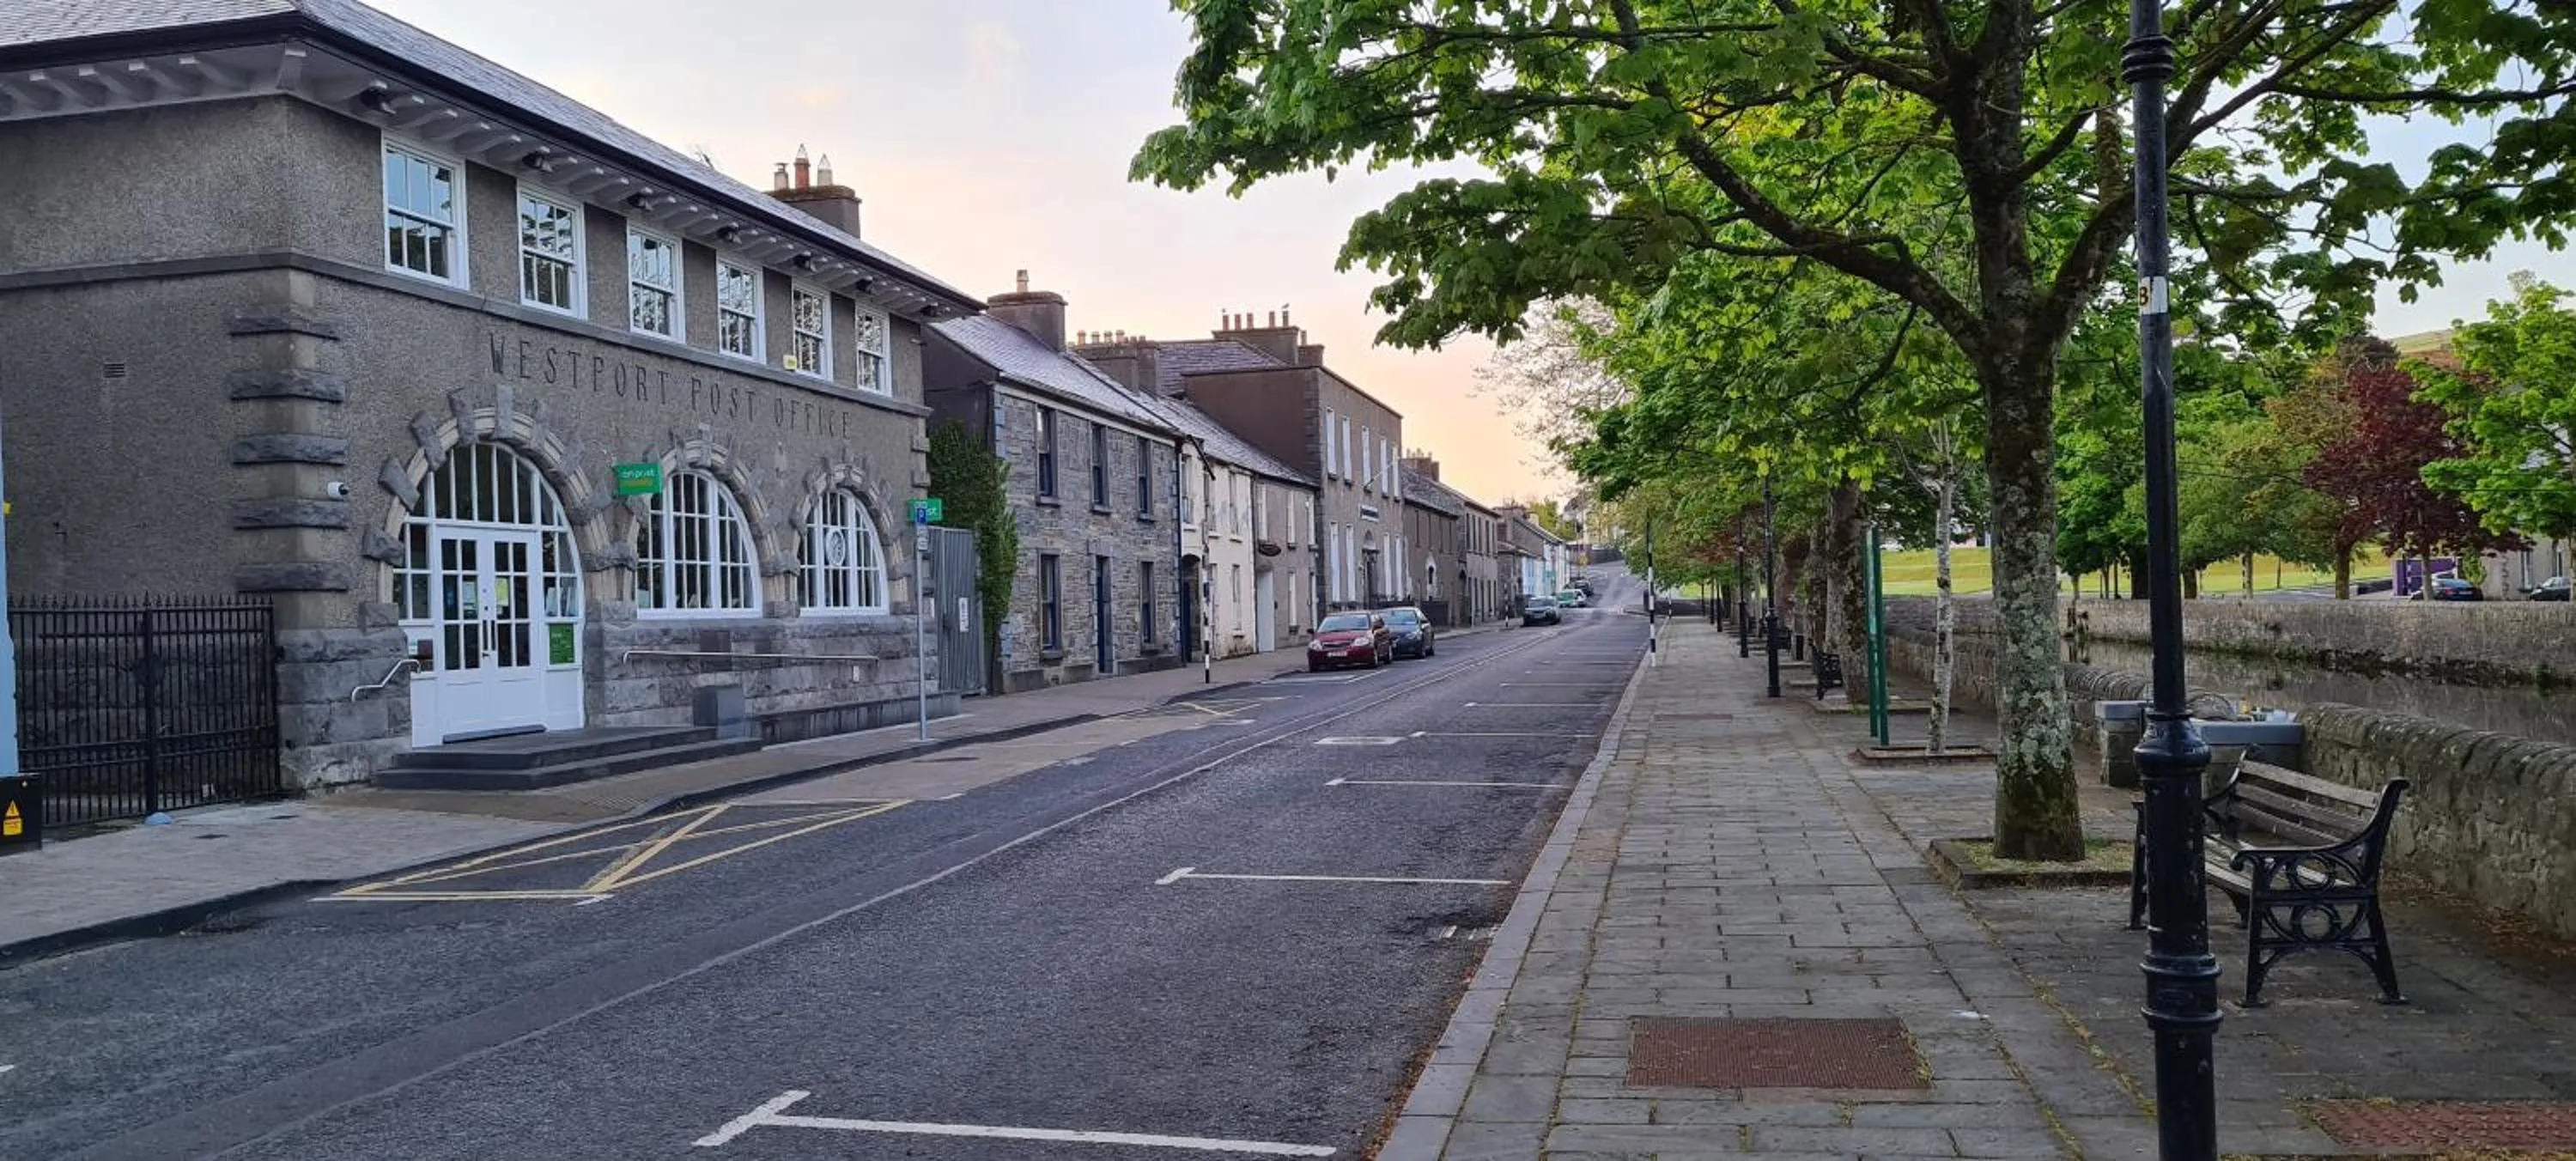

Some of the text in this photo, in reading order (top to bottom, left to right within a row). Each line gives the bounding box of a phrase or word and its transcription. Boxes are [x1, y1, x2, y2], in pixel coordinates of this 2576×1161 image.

[489, 332, 851, 441] WESTPORT POST OFFICE
